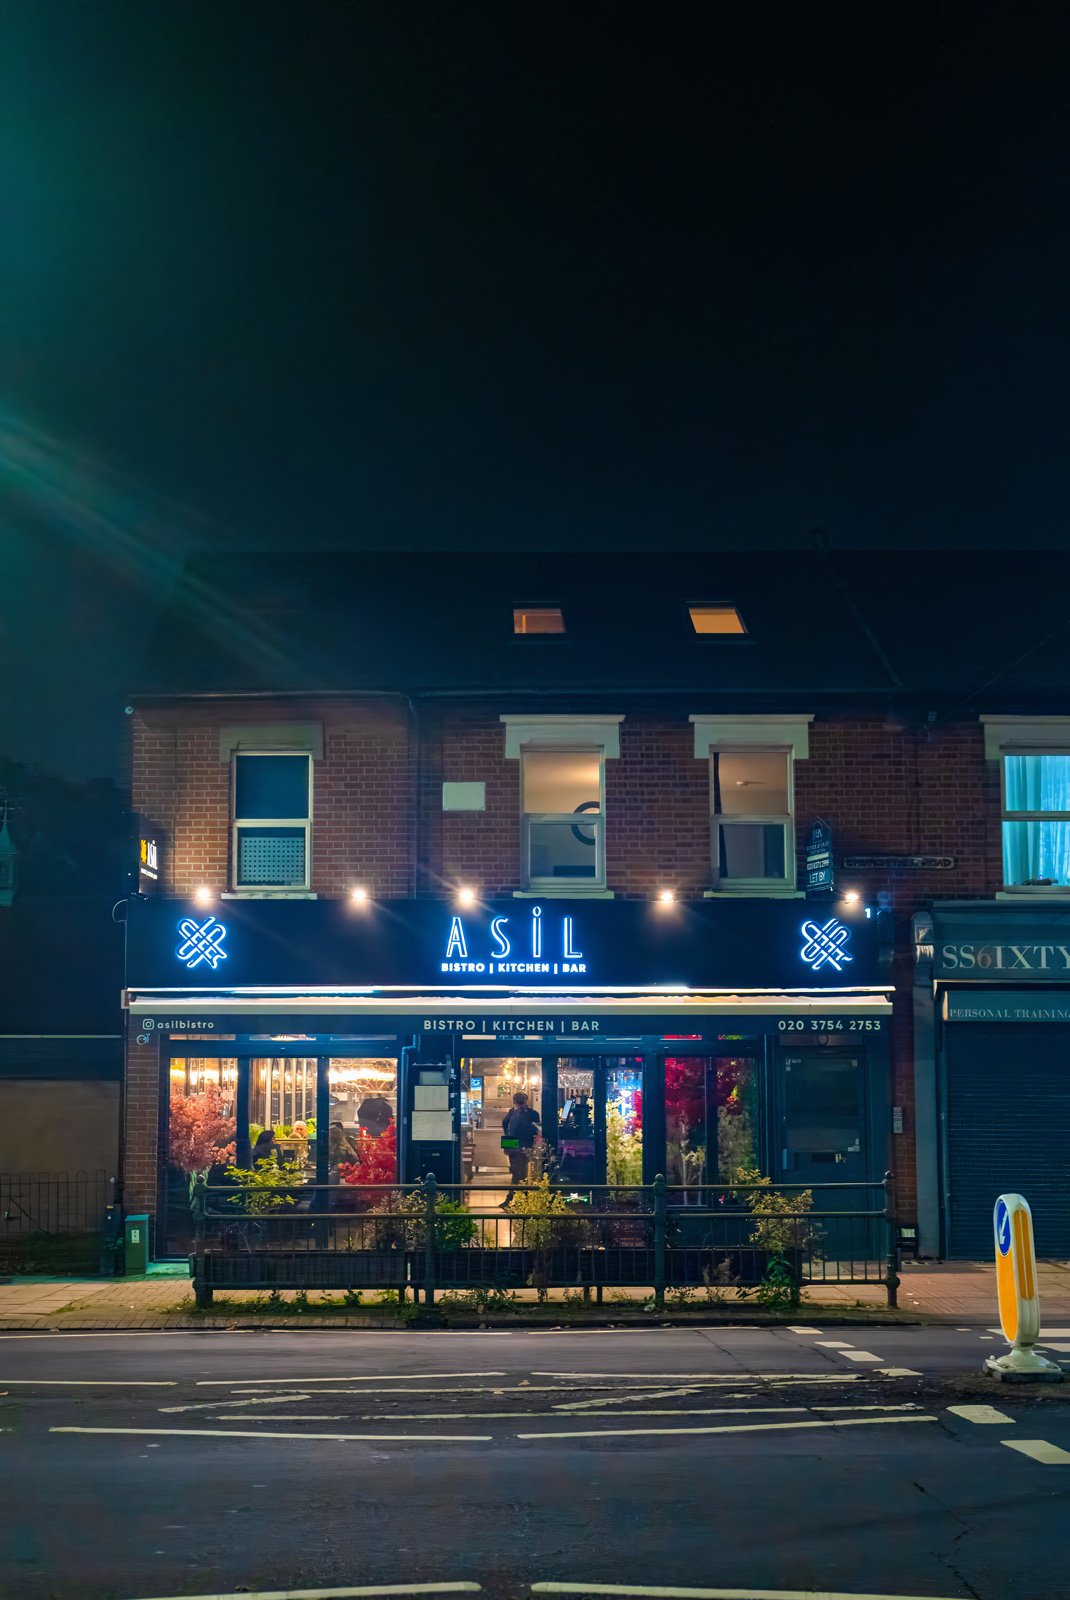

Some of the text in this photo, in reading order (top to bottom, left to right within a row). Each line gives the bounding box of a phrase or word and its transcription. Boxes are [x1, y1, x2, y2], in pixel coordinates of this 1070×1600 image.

[441, 962, 587, 973] BISTRO KITCHEN BAR
[949, 1008, 1011, 1018] PERSONAL
[157, 1020, 214, 1029] asilbistro
[423, 1020, 600, 1031] BISTRO KITCHEN BAR
[778, 1020, 881, 1031] 020 3754 2753
